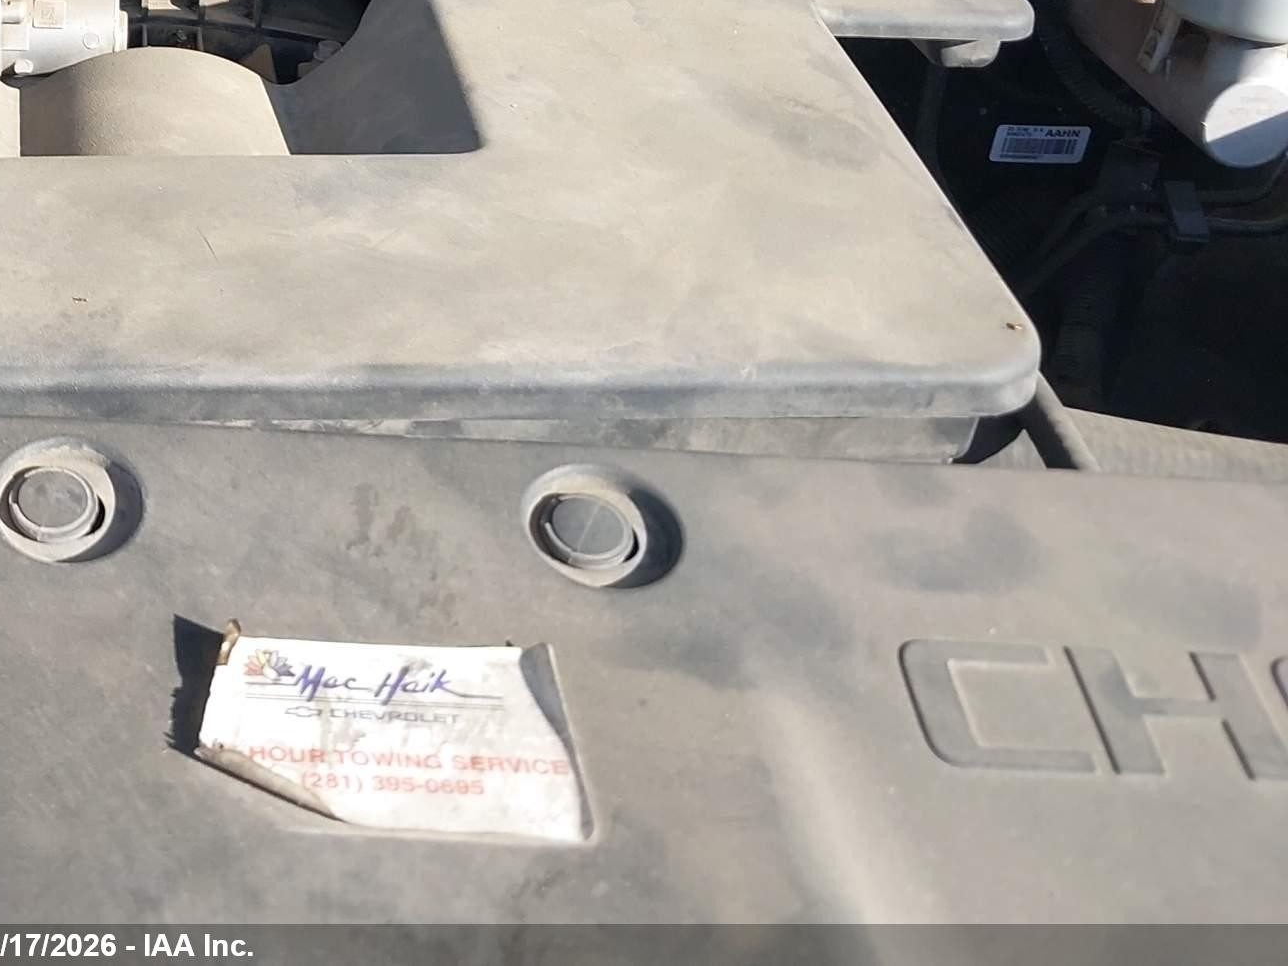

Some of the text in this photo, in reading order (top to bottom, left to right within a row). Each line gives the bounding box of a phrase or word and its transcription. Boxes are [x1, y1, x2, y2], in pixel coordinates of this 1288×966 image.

[329, 708, 459, 726] CHEVROLET
[898, 637, 1288, 782] CH
[248, 745, 570, 776] HOUR TOWING SERVICE
[301, 770, 363, 793] (281)
